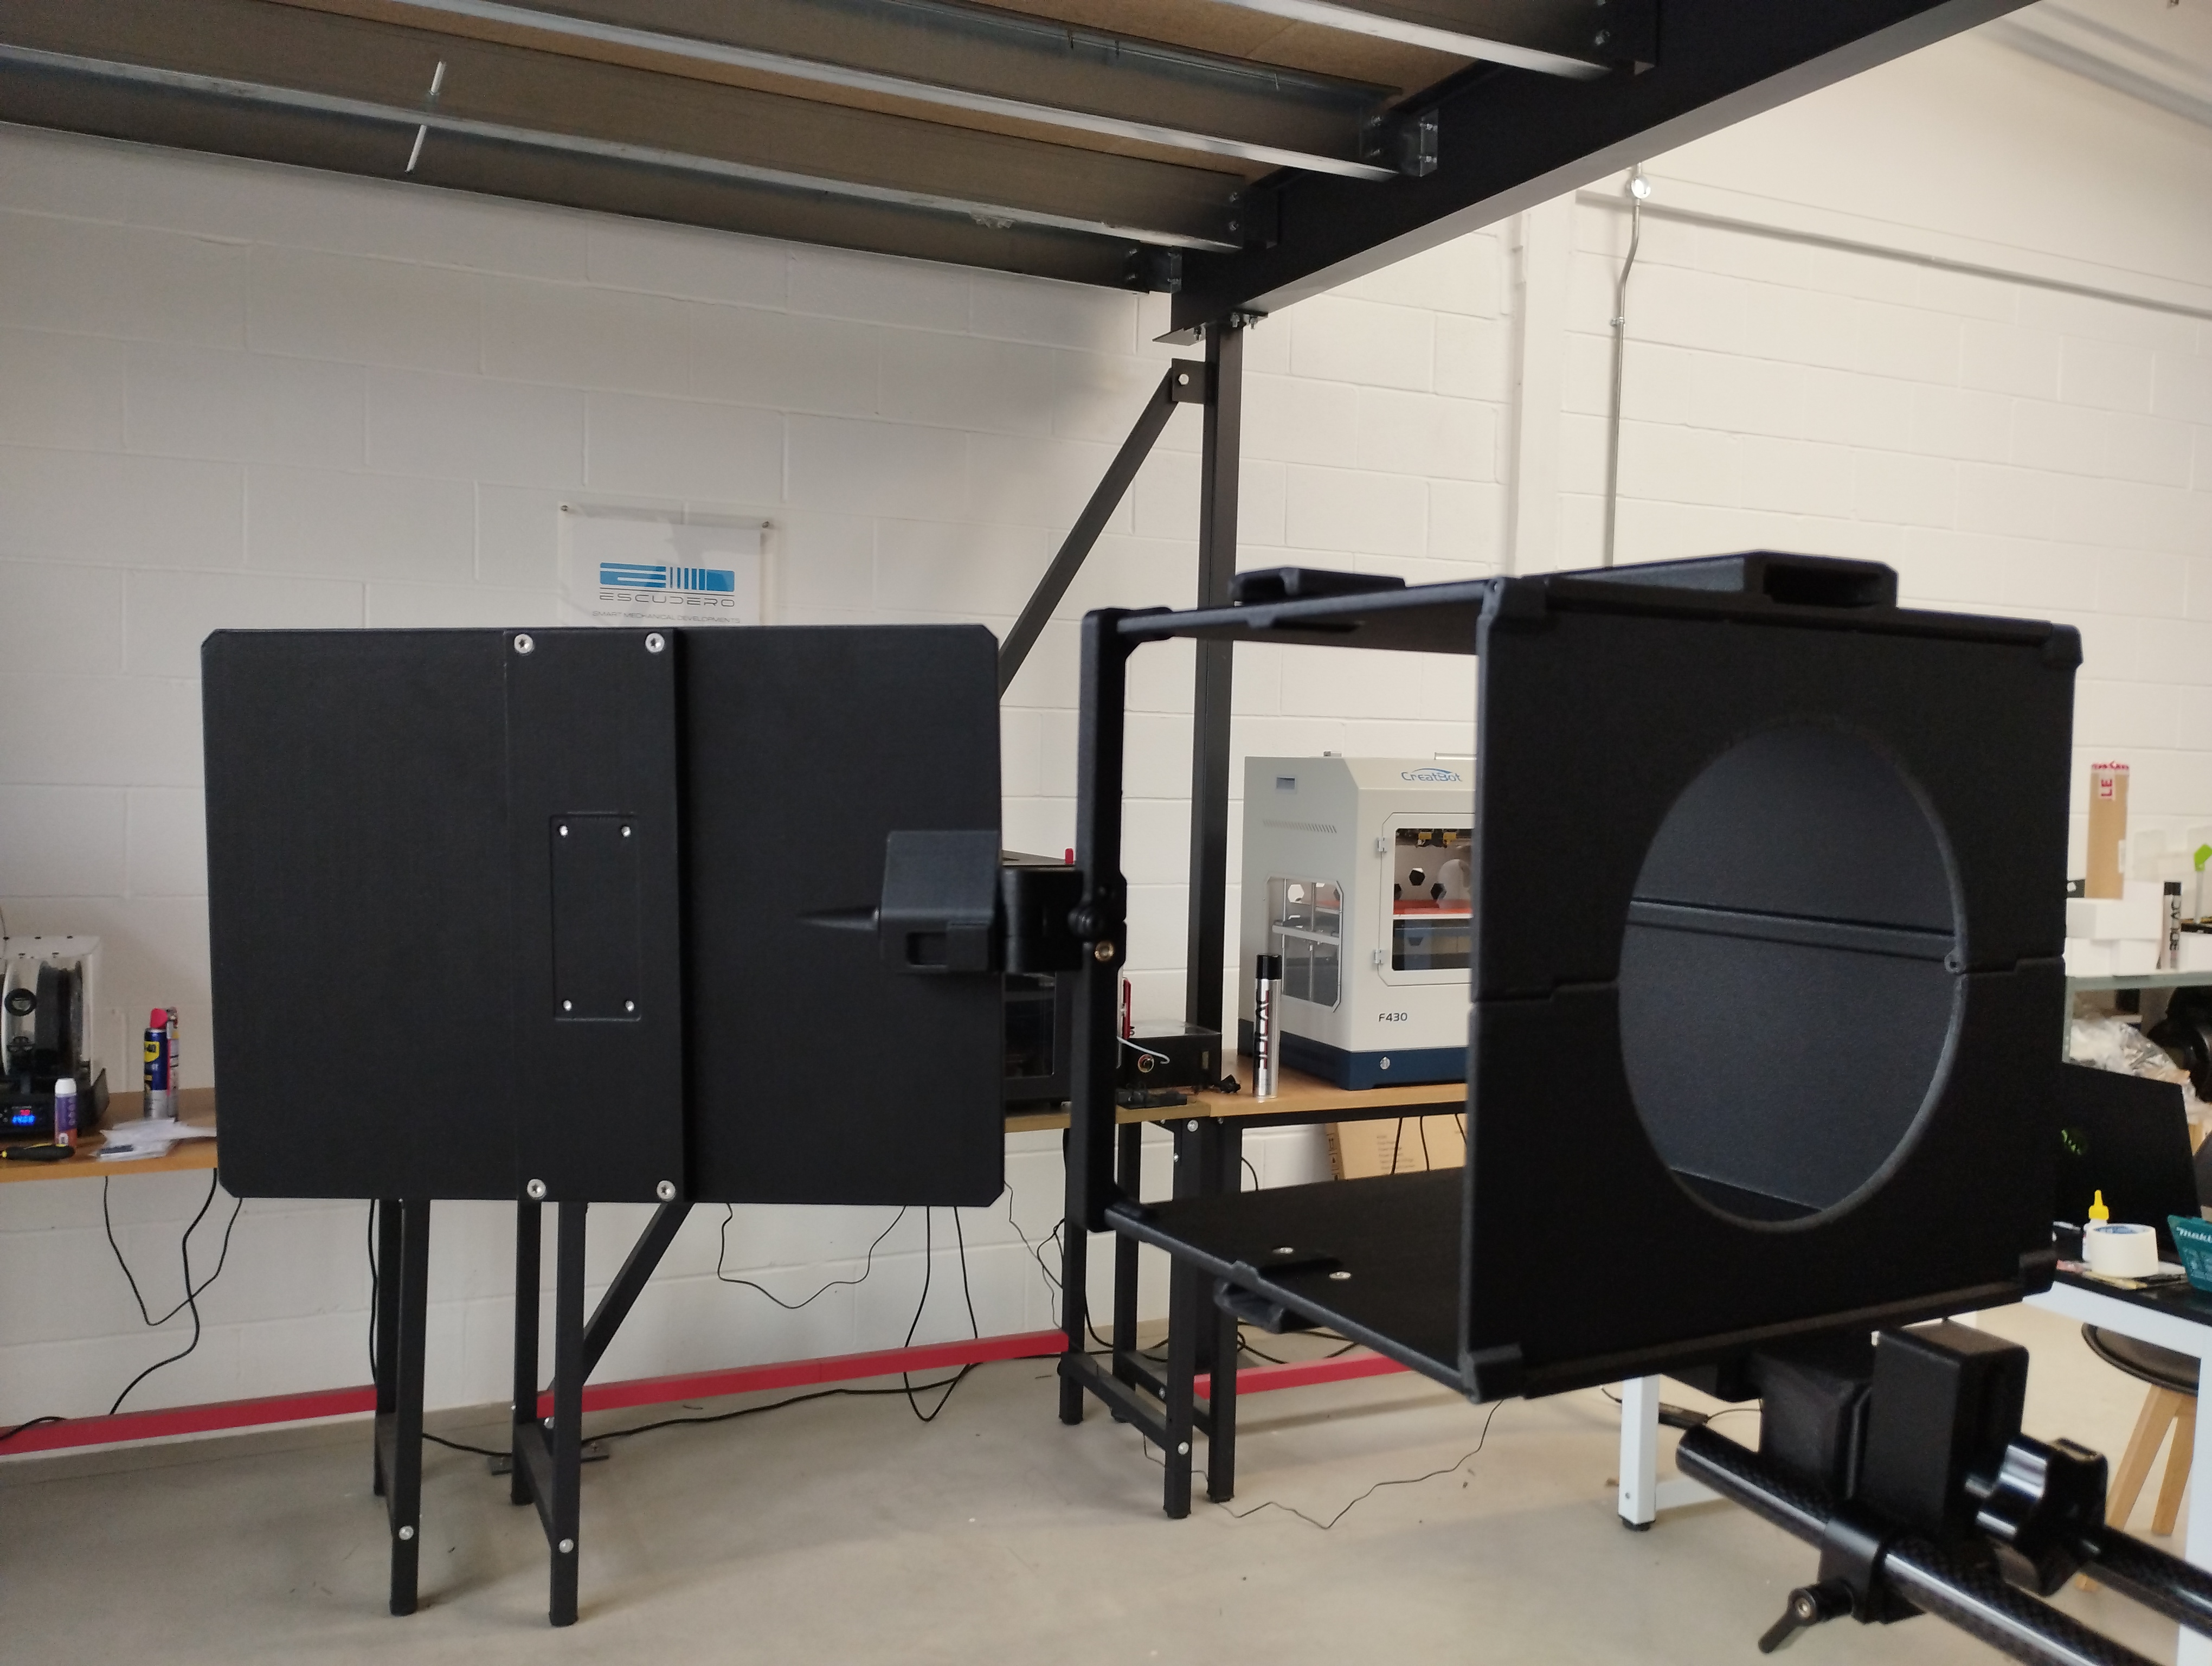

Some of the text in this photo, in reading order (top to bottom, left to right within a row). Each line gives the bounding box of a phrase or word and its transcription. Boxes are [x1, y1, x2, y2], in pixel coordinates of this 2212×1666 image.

[599, 592, 735, 607] ESCUDERO
[677, 615, 741, 624] DEVELOPMENTS
[1401, 771, 1462, 781] CreatBot
[1379, 1013, 1407, 1021] F430
